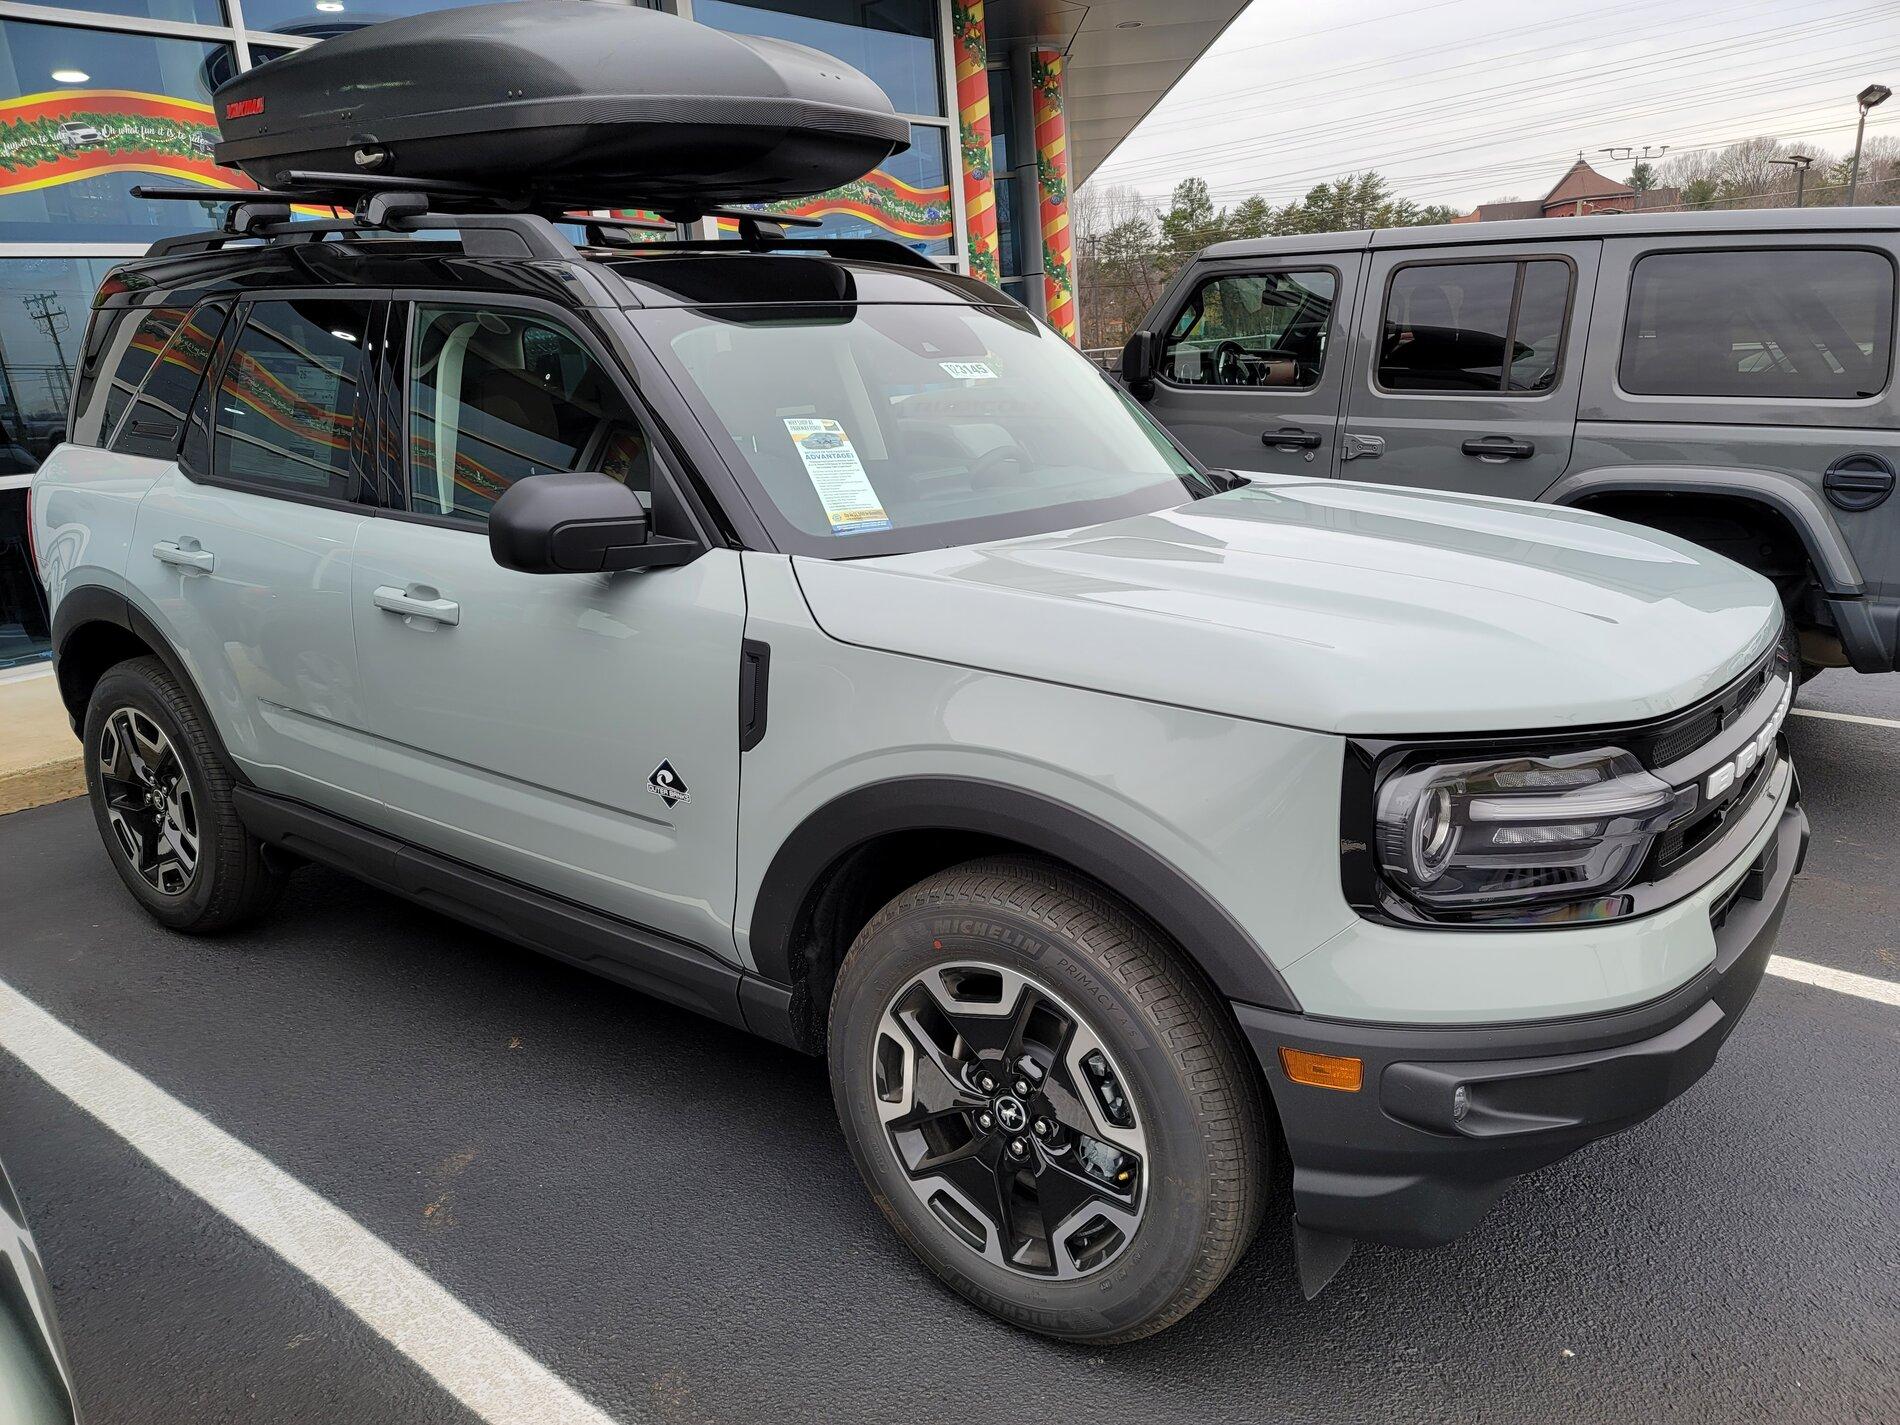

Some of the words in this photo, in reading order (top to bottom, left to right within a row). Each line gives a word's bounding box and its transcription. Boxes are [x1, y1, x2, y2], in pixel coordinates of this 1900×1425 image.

[102, 124, 116, 138] Oh
[118, 123, 140, 135] what
[141, 125, 156, 141] fun
[157, 126, 166, 137] it
[934, 919, 1042, 956] MICHELIN
[1057, 958, 1120, 1012] PRIMACY
